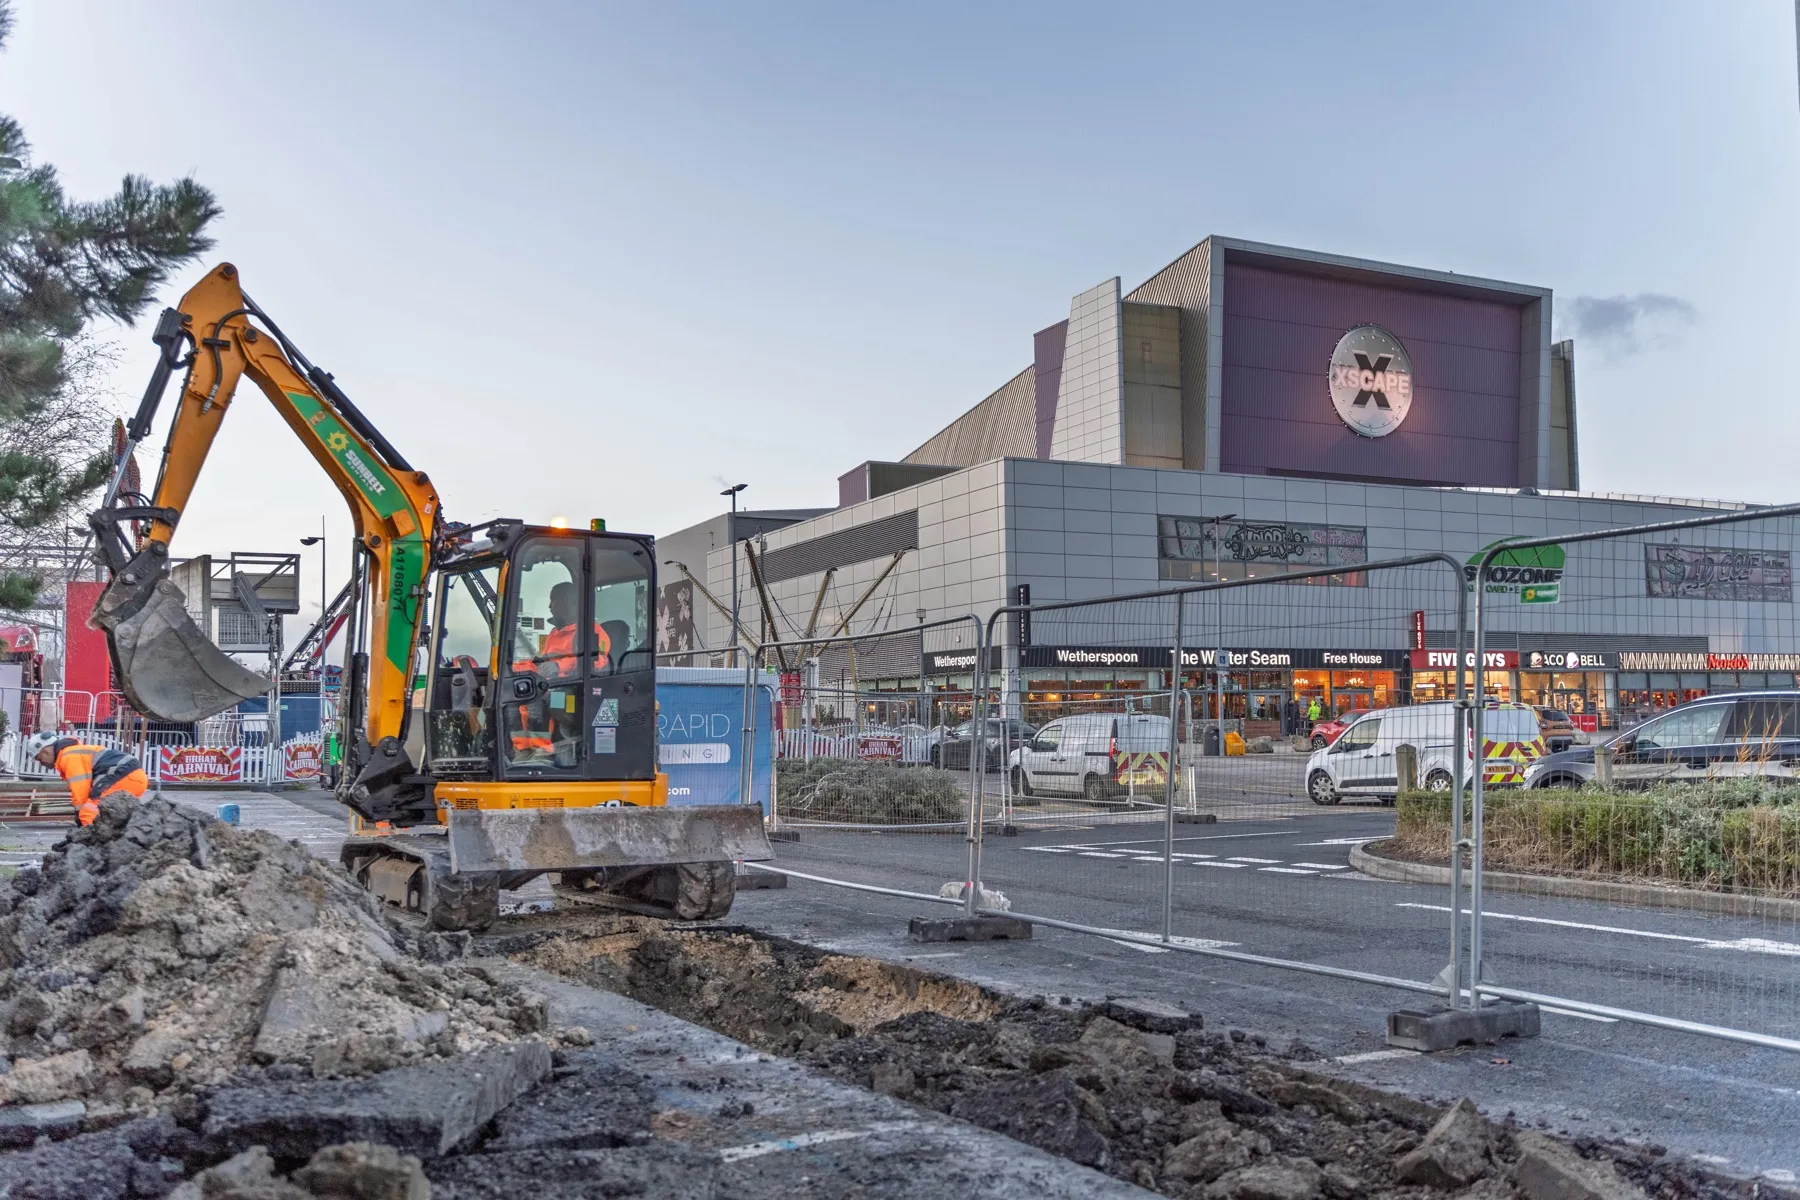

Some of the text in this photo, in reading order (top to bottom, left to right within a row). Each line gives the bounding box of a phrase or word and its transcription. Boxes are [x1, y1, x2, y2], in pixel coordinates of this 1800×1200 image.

[1333, 366, 1411, 394] XSCAPE
[345, 449, 386, 494] SUNBELT
[393, 546, 405, 612] A1168071
[1463, 565, 1563, 584] SOZONE
[934, 655, 977, 668] Wetherspoo
[1057, 650, 1138, 665] Wetherspoon
[1200, 650, 1249, 665] Wter
[1251, 650, 1291, 665] Seam
[1323, 652, 1382, 664] Free House
[1580, 654, 1605, 666] BELL
[185, 755, 217, 763] URBAN
[169, 762, 232, 776] CARNIVAL
